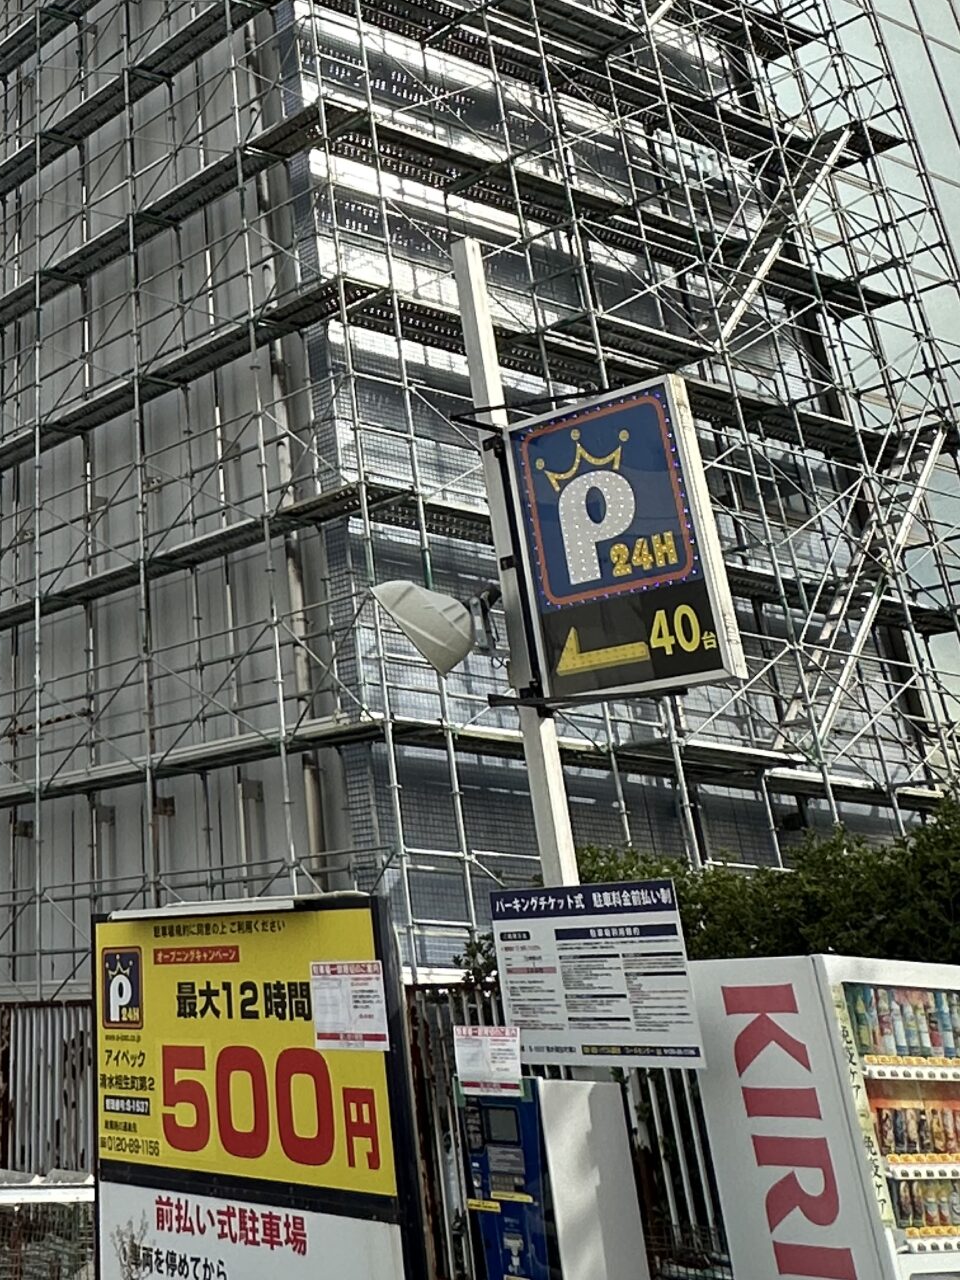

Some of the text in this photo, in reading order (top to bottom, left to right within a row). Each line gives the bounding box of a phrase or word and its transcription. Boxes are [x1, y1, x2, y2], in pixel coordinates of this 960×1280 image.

[609, 530, 678, 577] 24H
[649, 604, 718, 656] 40台
[495, 893, 585, 913] パーキングチケット式
[176, 980, 312, 1022] 最大12時間
[161, 1044, 381, 1170] 500円
[155, 1195, 308, 1257] 前払い式駐車場
